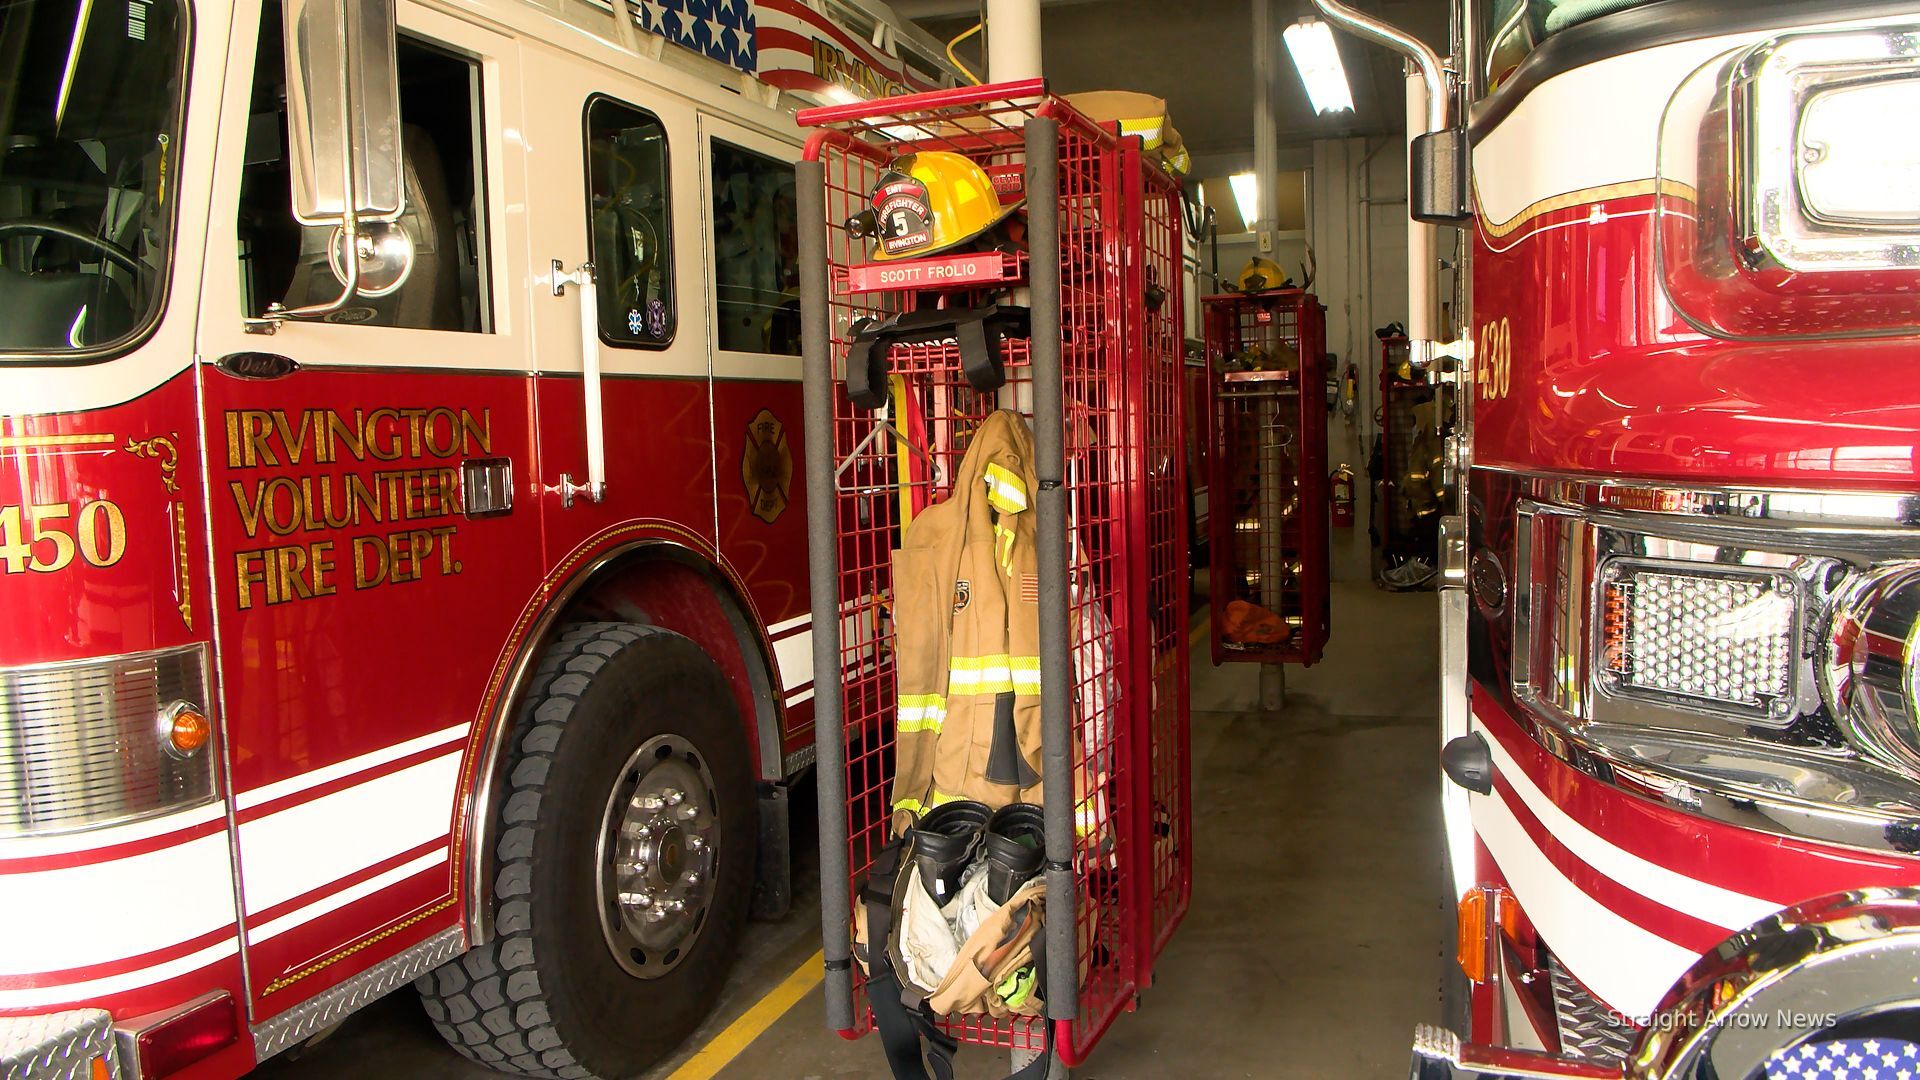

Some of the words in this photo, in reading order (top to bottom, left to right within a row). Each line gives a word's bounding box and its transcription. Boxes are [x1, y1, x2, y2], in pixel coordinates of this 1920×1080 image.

[885, 184, 903, 195] EMT
[880, 199, 925, 224] FIREFIGHTER
[892, 211, 909, 237] 5
[888, 232, 927, 250] IRVINGTON
[880, 268, 922, 283] SCOTT
[928, 263, 977, 279] FROLIO
[1477, 316, 1511, 400] 430
[224, 407, 492, 469] IRVINGTON
[757, 422, 776, 434] FIRE
[229, 468, 463, 538] VOLUNTEER
[0, 499, 126, 574] 450
[234, 541, 337, 611] FIRE
[352, 526, 464, 590] DEPT.
